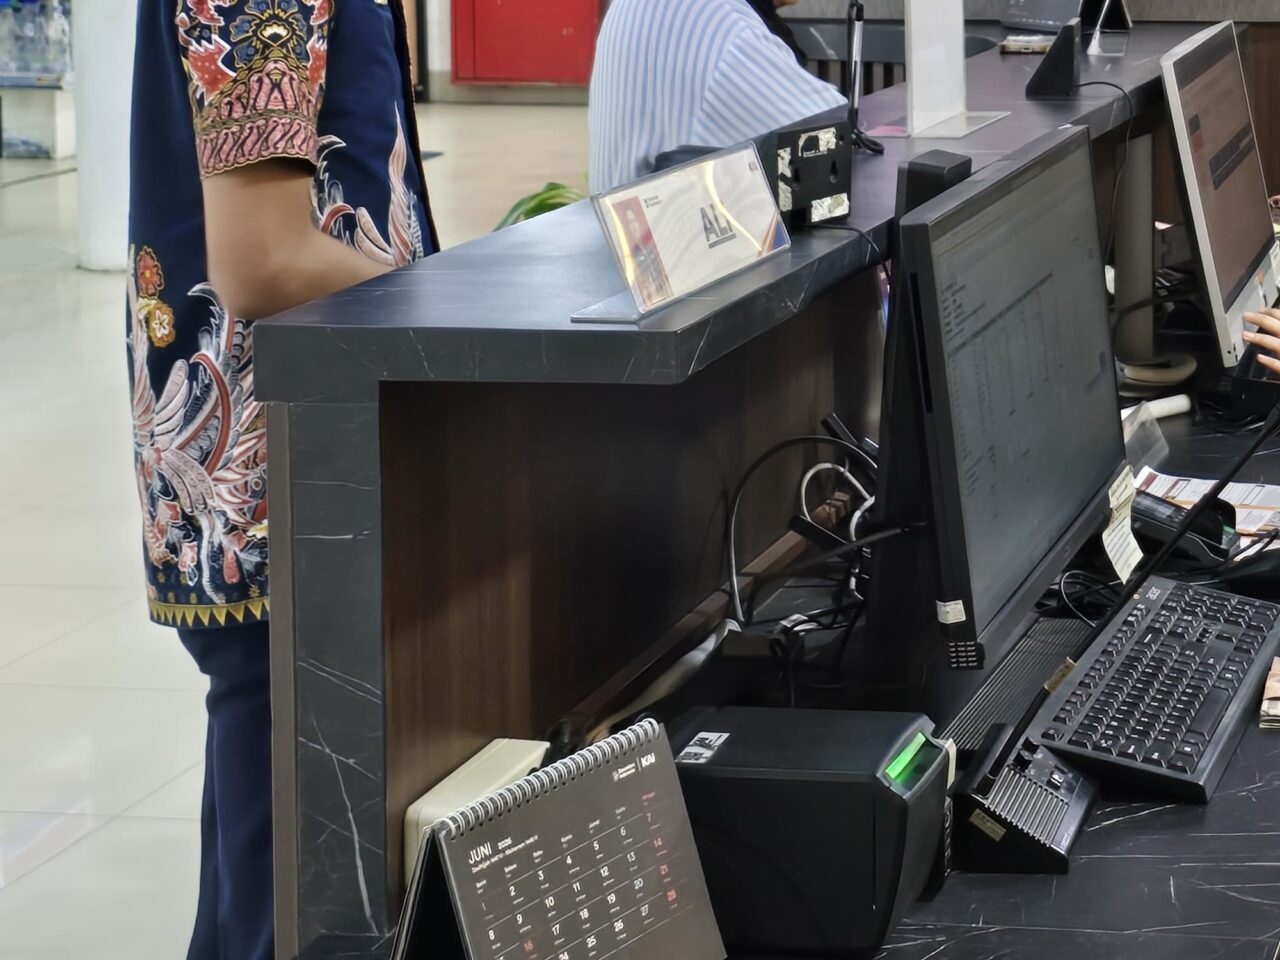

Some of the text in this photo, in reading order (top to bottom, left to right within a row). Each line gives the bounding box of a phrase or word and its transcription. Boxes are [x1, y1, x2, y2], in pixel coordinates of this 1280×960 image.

[641, 752, 656, 768] KAI
[468, 842, 492, 864] JUNI
[509, 826, 626, 896] 2 3 4 5 6
[488, 930, 495, 940] 8
[516, 914, 523, 924] 9
[545, 897, 554, 908] 10
[573, 882, 581, 892] 11
[600, 866, 609, 877] 12
[627, 852, 636, 862] 13
[523, 941, 533, 952] 16
[552, 924, 560, 935] 17
[579, 909, 589, 920] 18
[607, 893, 616, 904] 19
[634, 879, 643, 889] 20
[587, 936, 597, 947] 25
[614, 919, 623, 931] 26
